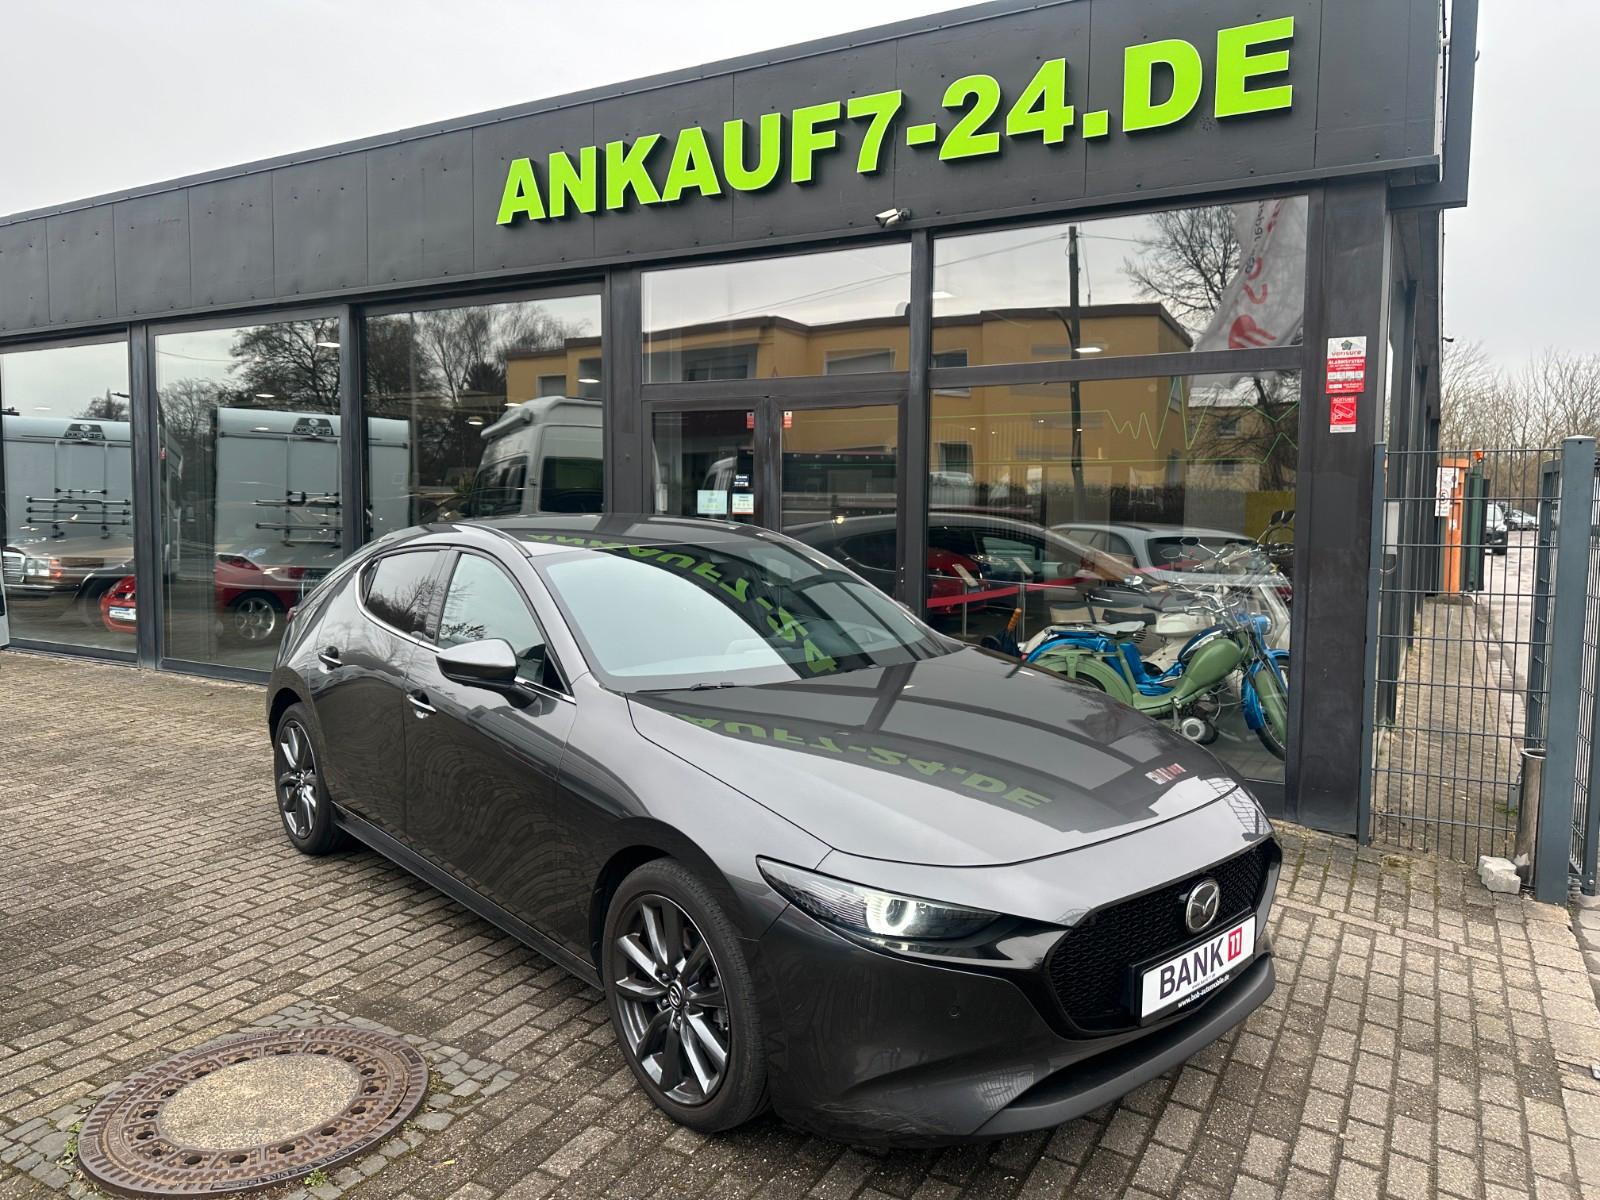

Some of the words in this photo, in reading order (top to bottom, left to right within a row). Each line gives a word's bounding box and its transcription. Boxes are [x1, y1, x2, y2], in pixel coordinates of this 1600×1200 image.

[495, 16, 1296, 226] ANKAUF7-24.DE
[1441, 492, 1446, 501] 5
[1159, 936, 1224, 1000] BANK
